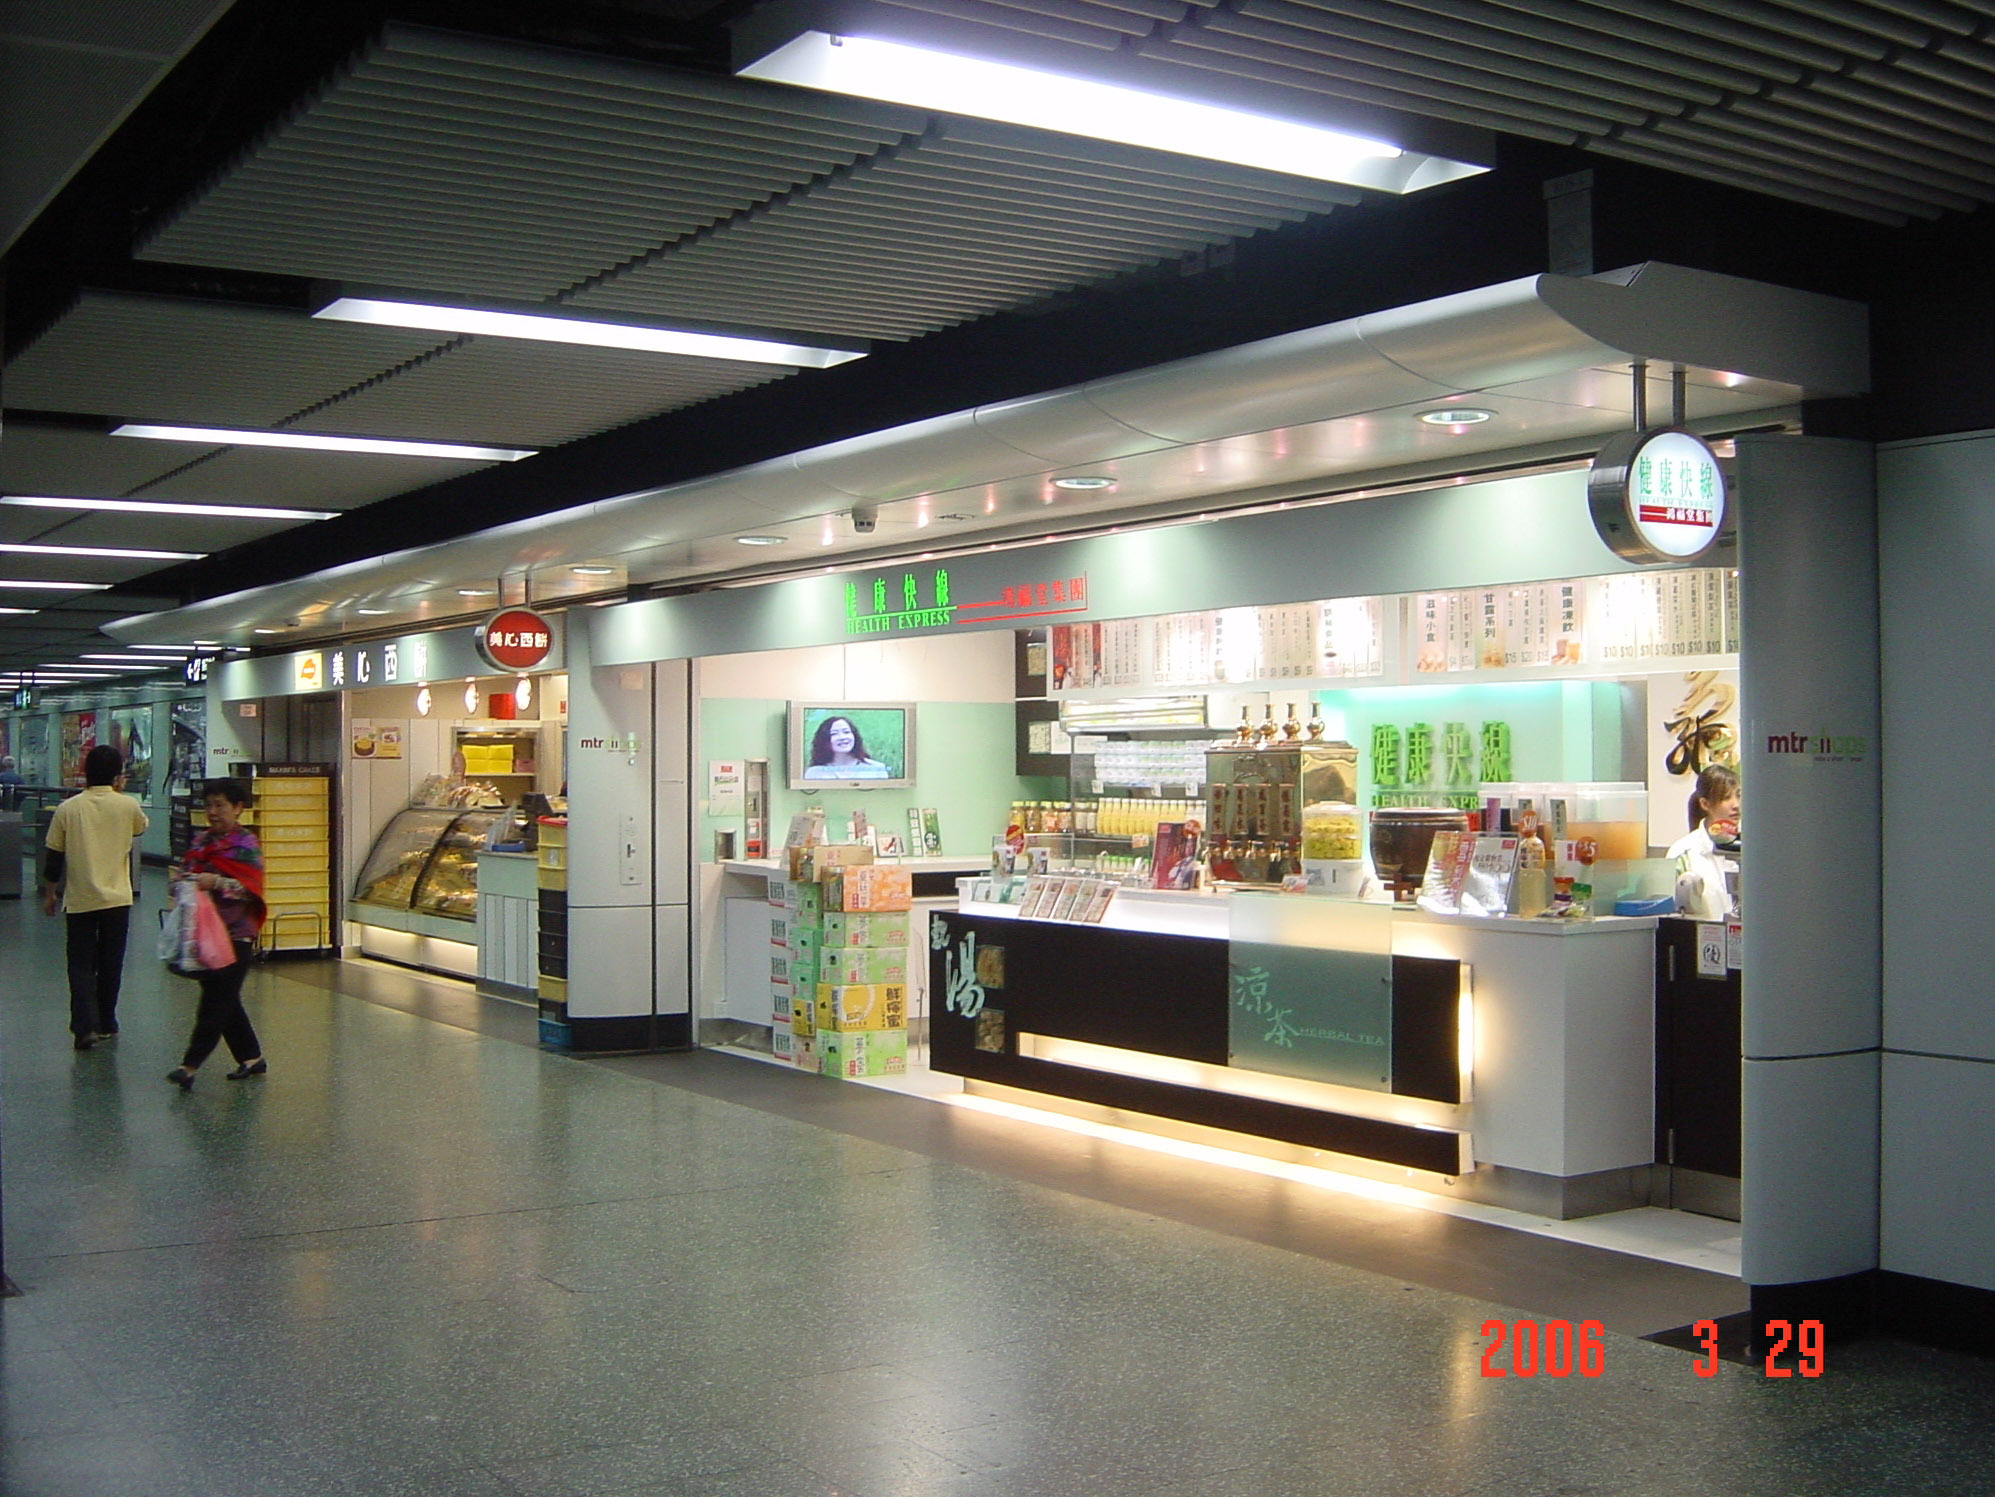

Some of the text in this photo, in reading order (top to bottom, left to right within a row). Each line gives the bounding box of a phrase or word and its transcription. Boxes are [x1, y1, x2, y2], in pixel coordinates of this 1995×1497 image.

[847, 609, 950, 634] HEALTH EXPRESS
[490, 631, 548, 648] 美心西餅
[1234, 967, 1300, 1048] 涼茶
[1300, 1028, 1385, 1046] HERBAL TEA
